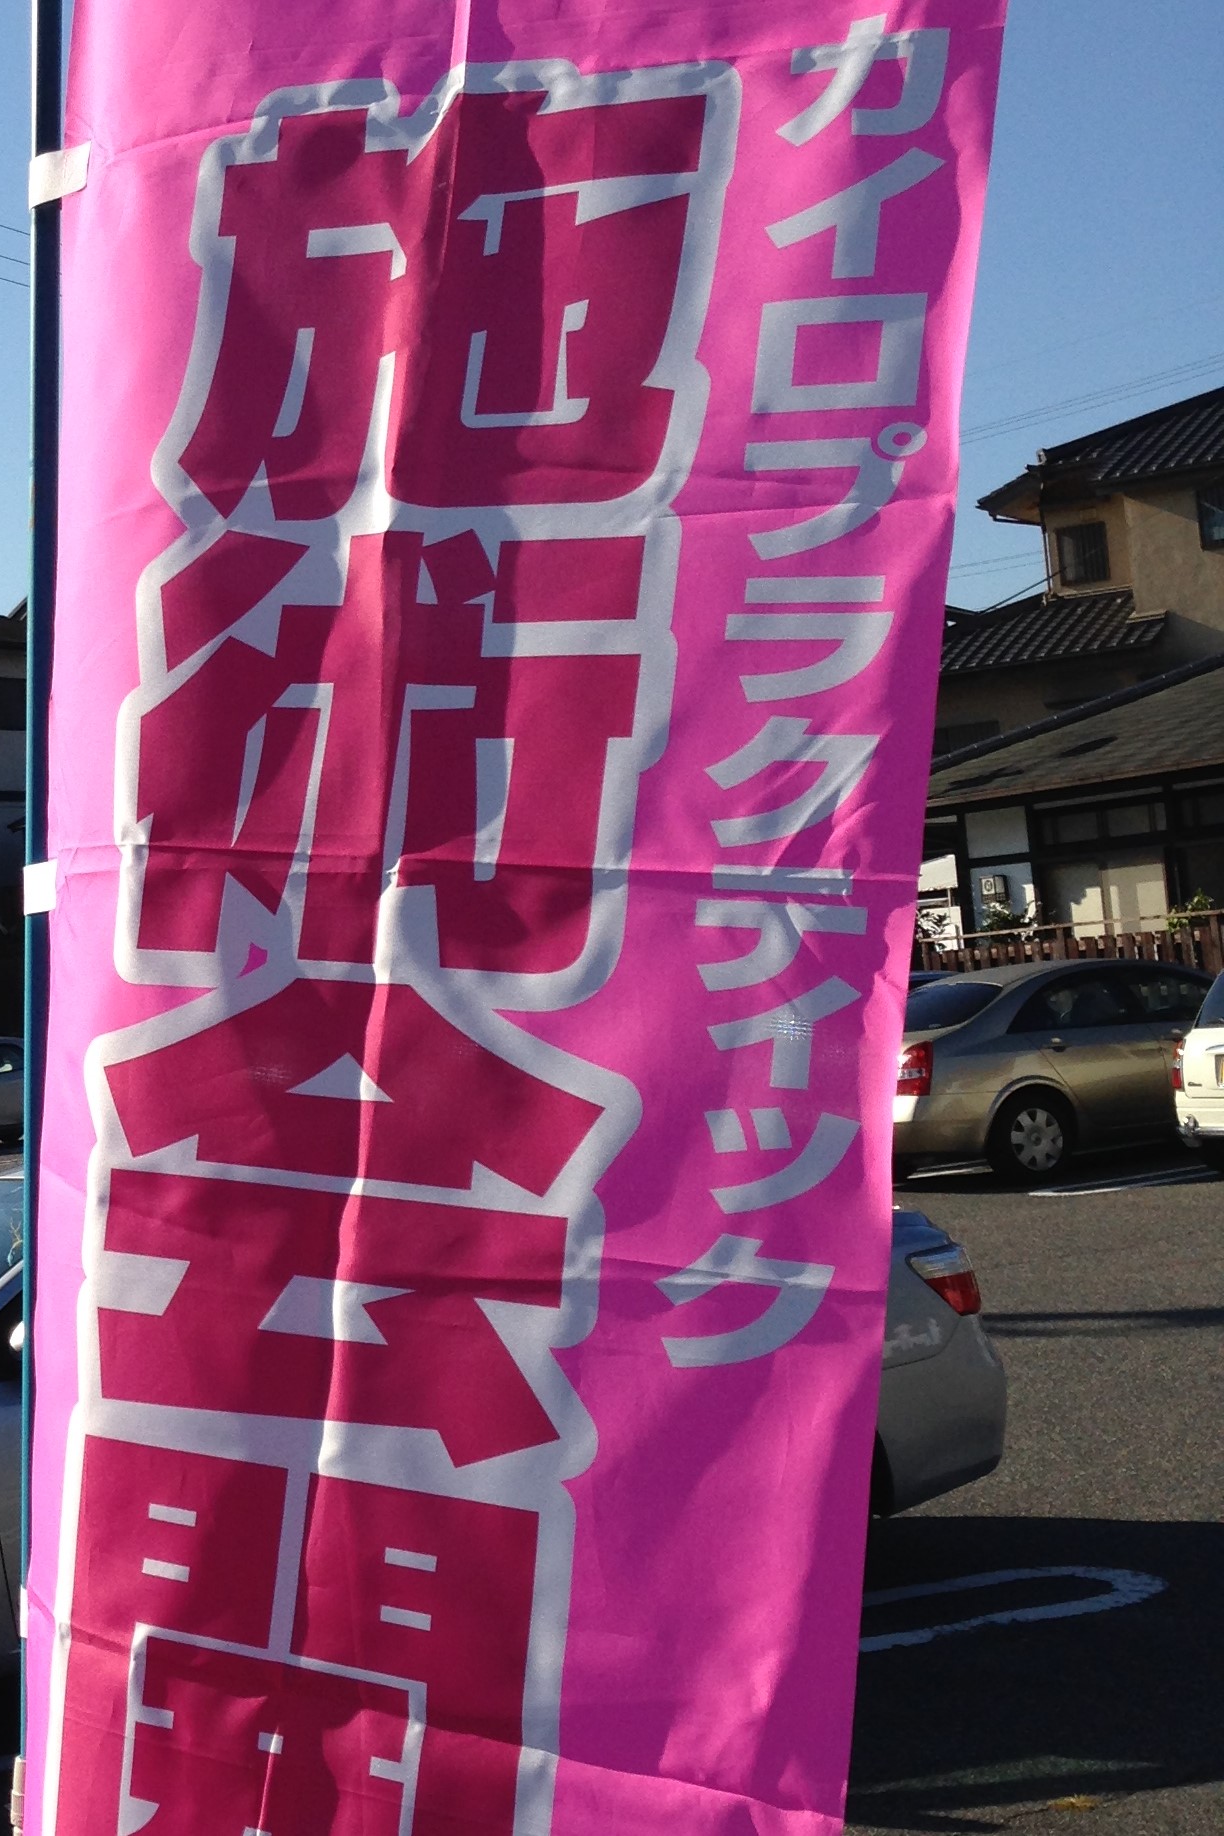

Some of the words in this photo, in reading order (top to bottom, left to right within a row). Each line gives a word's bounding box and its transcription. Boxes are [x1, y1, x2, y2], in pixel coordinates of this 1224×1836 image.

[58, 64, 736, 1836] 施術会開
[656, 14, 950, 1369] カイロプラクティック
